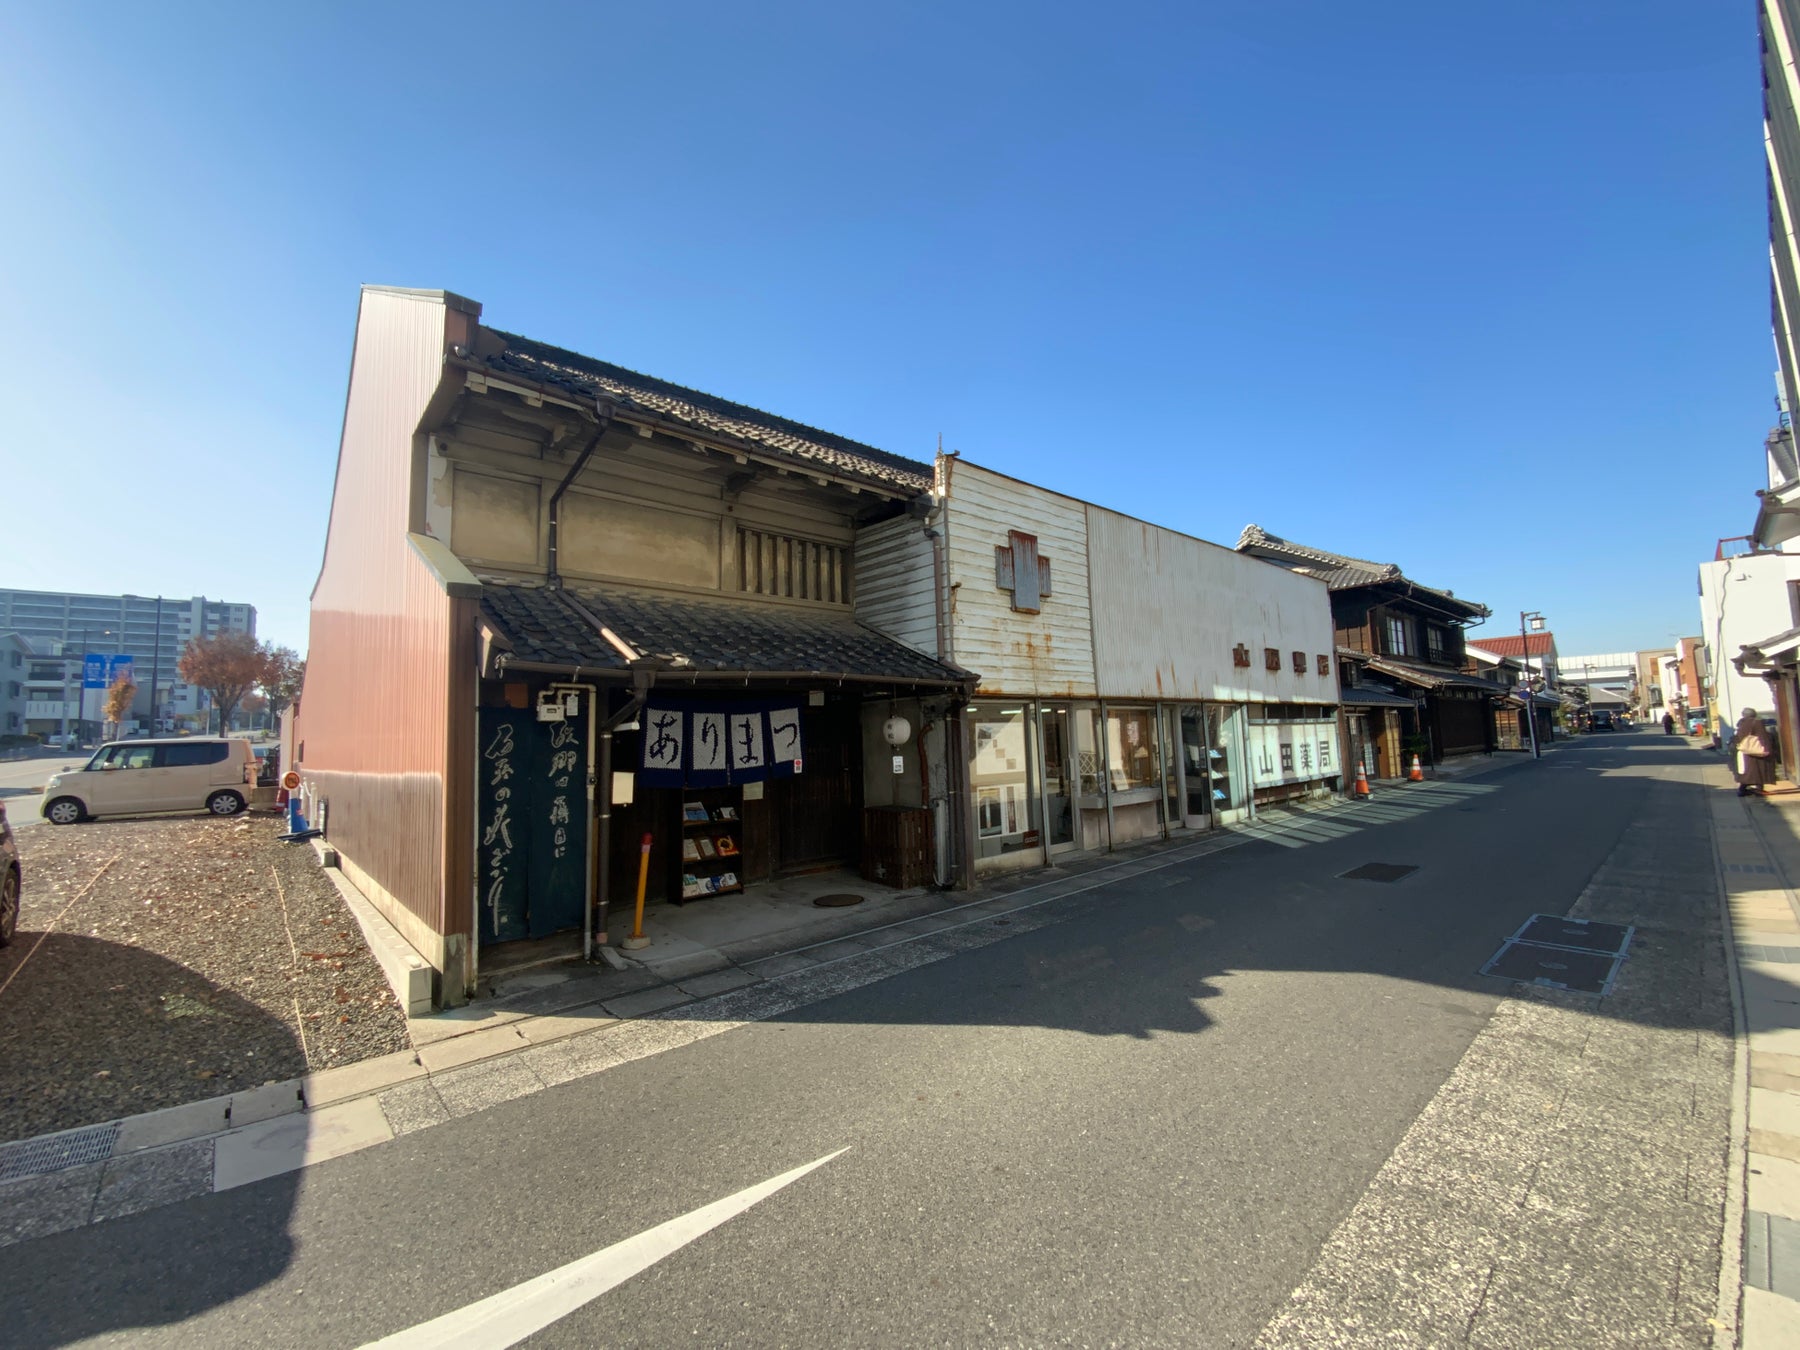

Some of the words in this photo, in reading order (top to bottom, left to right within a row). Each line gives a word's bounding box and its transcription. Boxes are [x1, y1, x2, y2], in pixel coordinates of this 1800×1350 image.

[650, 713, 797, 765] ありまつ
[1258, 740, 1331, 776] 山田薬局
